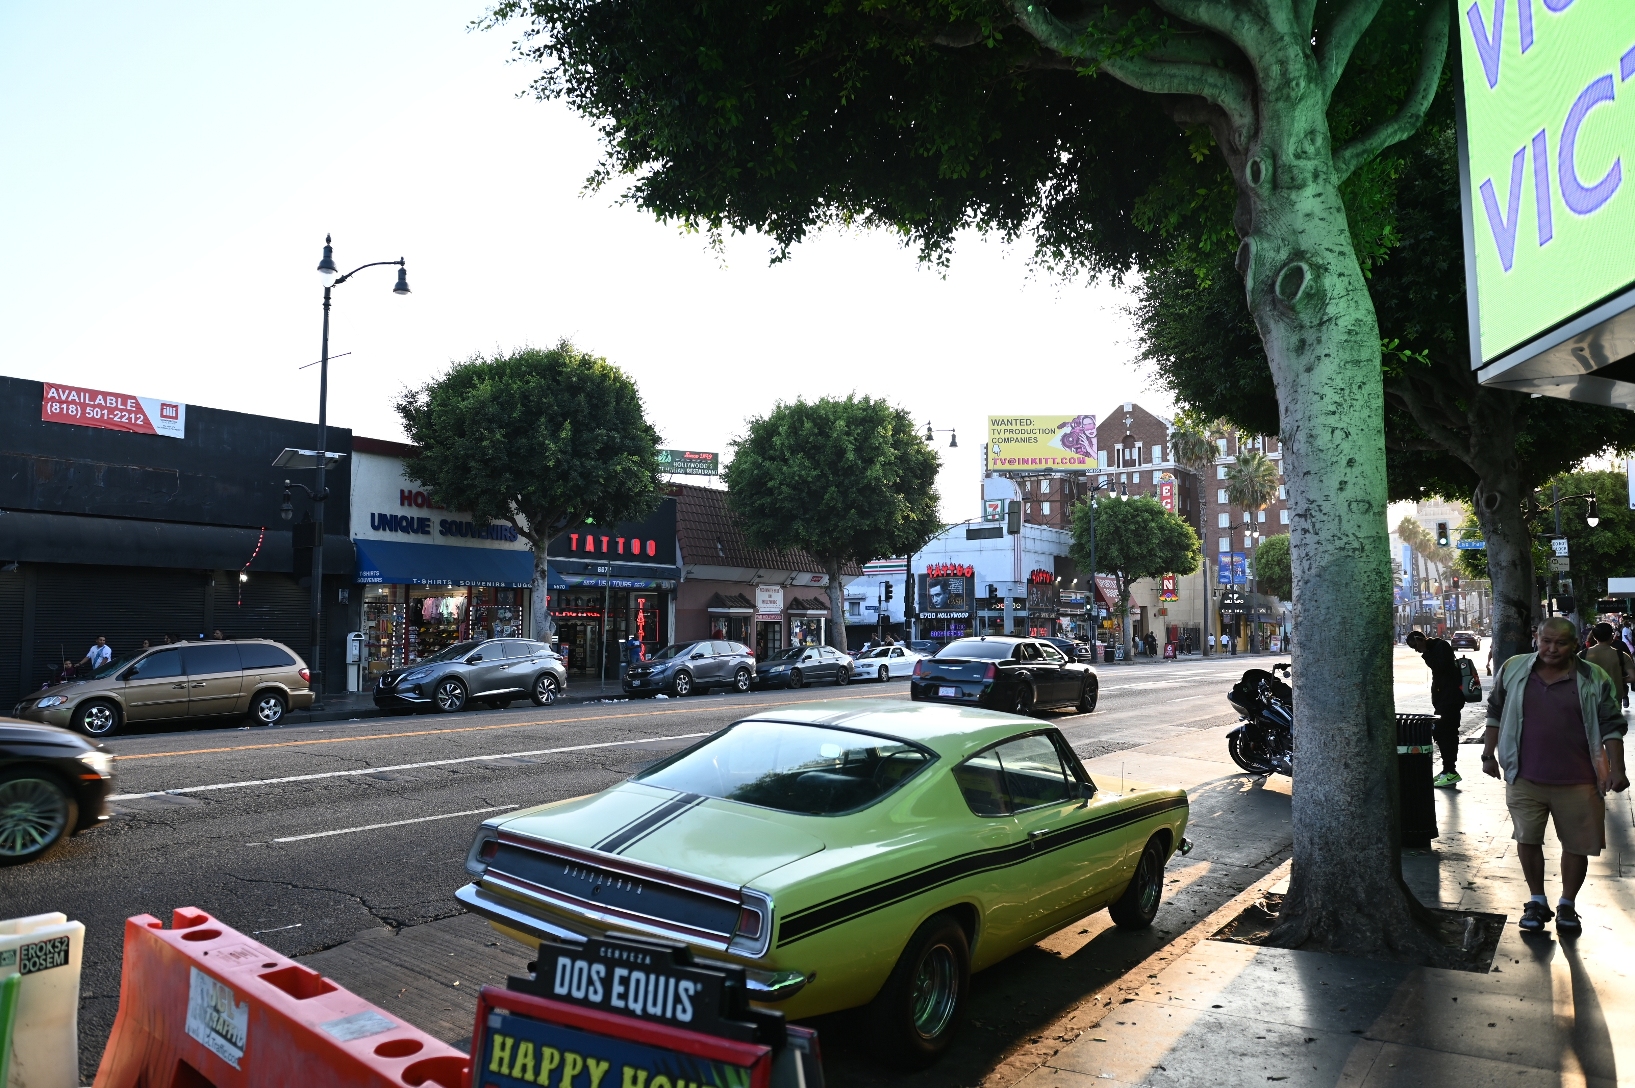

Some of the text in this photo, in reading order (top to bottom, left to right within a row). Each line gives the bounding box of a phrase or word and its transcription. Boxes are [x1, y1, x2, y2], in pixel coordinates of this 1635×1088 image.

[47, 388, 136, 410] AVAILABLE
[47, 402, 144, 424] (818) 501-2212
[991, 418, 1035, 426] WANTED:
[992, 457, 1086, 466] TV@INKITT.COM
[370, 512, 518, 542] UNIQUE SOUVENIRS
[569, 533, 656, 557] TATTOO
[927, 562, 973, 578] TATTOO
[612, 580, 632, 588] TOURS
[21, 936, 68, 960] EROK52
[600, 946, 650, 964] CERVEZA
[21, 951, 65, 973] DOSEM
[554, 956, 695, 1022] DOS EQUIS
[205, 1008, 244, 1047] TRAFFIC
[488, 1034, 610, 1088] HAPPY
